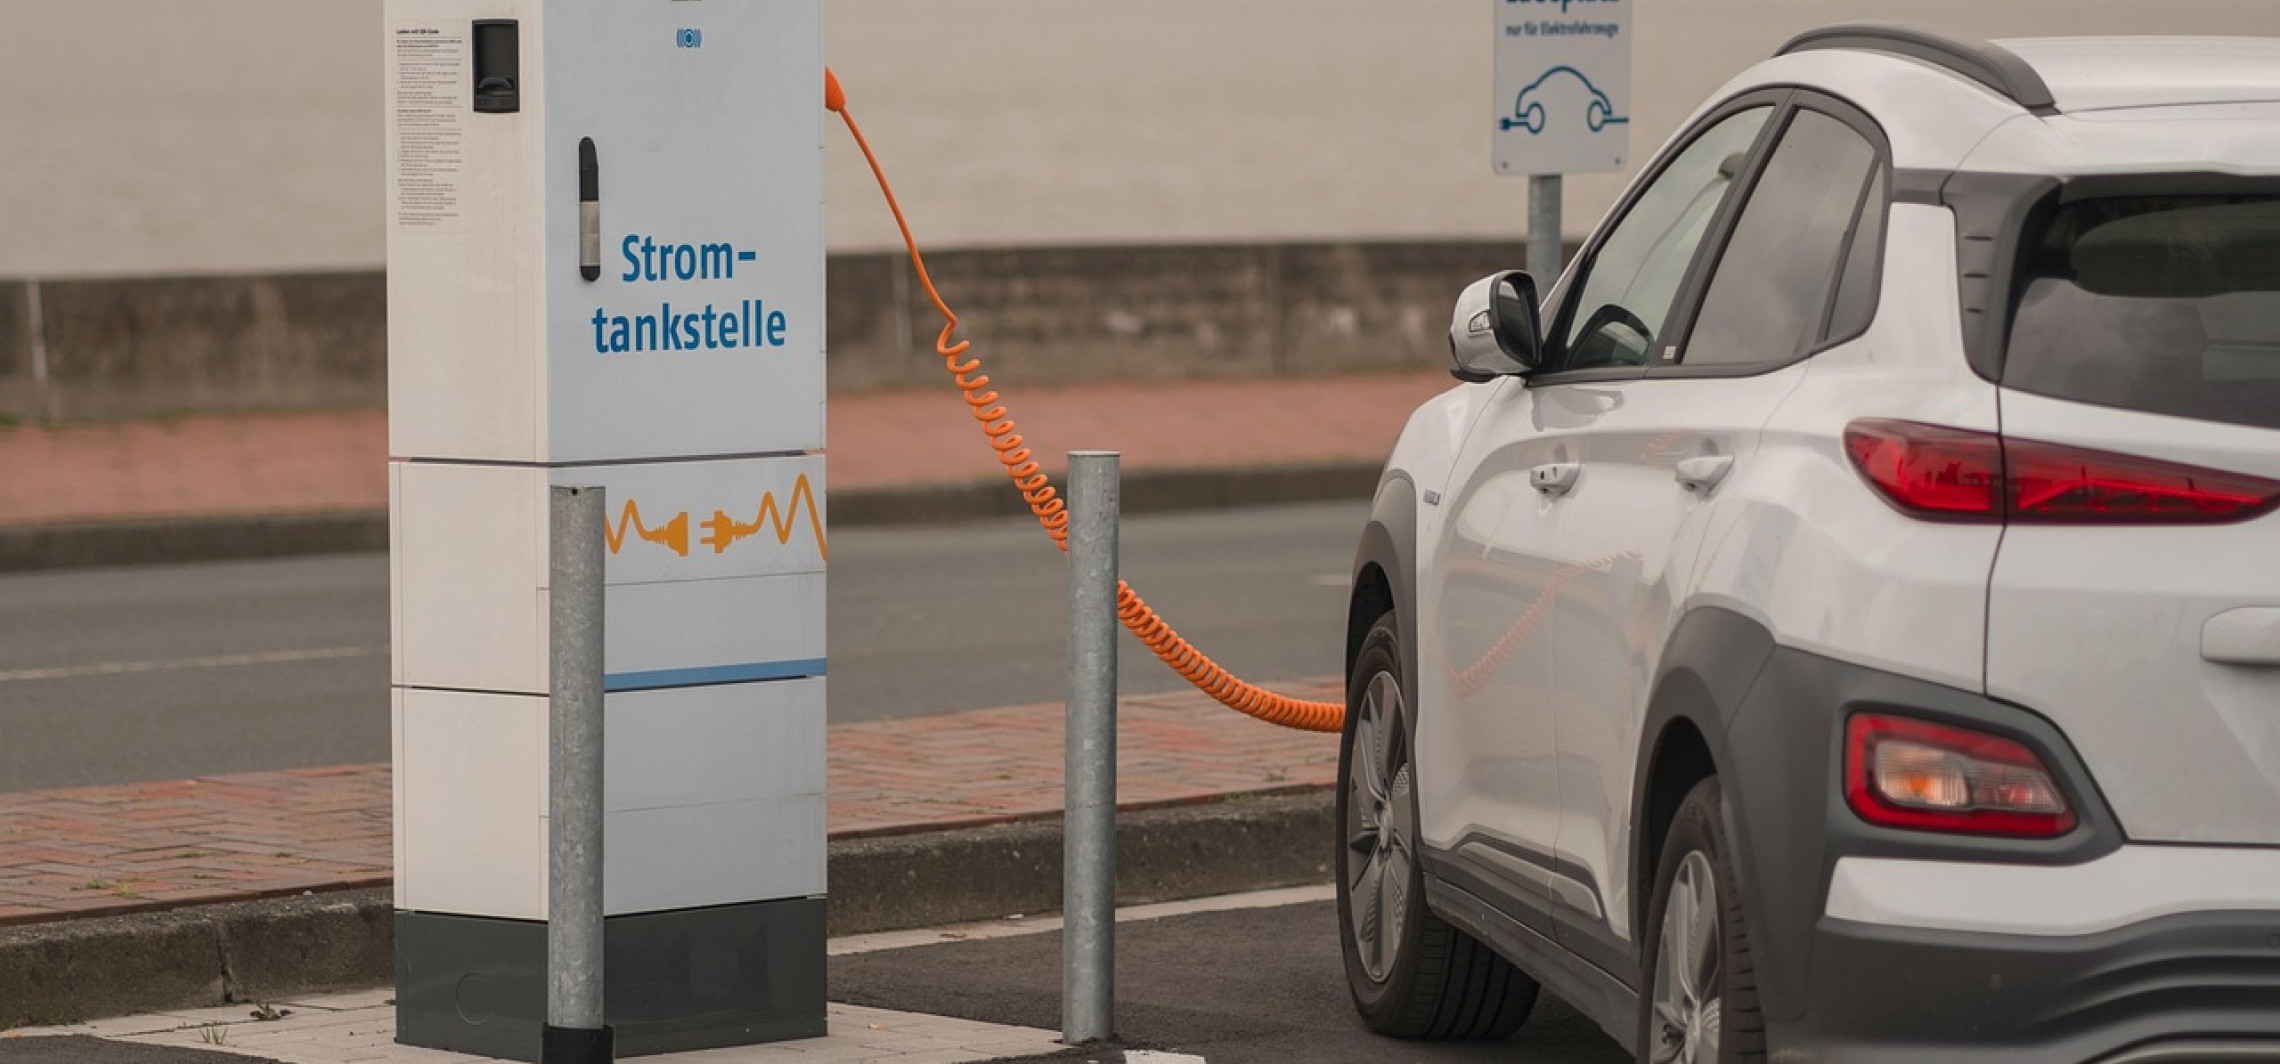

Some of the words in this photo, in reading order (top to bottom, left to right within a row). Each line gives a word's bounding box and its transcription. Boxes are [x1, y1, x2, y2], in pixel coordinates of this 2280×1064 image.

[1506, 25, 1521, 35] nur
[1524, 21, 1537, 35] für
[1541, 20, 1619, 38] Elektrofahrzeuge
[621, 233, 756, 282] Strom-
[592, 299, 786, 353] tankstelle
